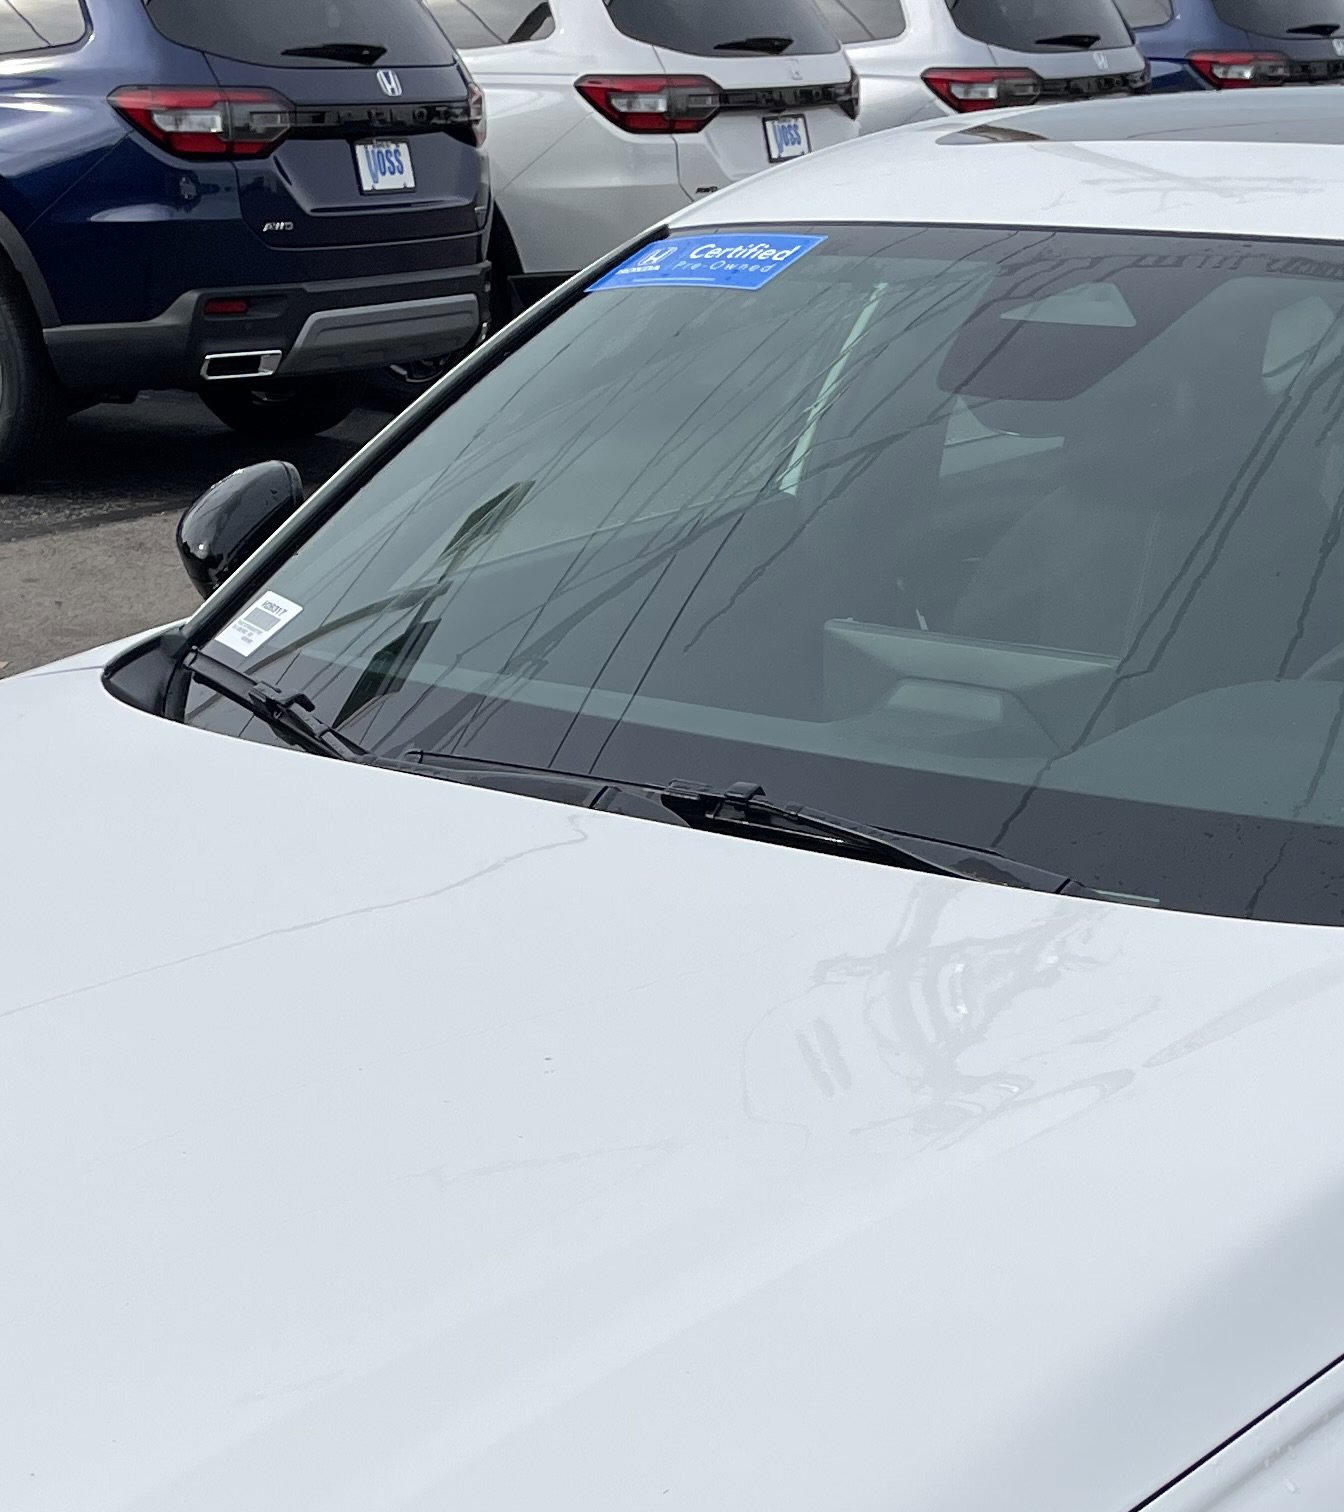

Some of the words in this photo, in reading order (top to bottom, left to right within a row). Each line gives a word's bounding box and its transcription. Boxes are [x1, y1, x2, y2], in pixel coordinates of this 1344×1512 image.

[364, 149, 404, 184] VOSS
[262, 220, 294, 232] AWD
[689, 243, 801, 261] Certified
[672, 260, 777, 274] Pre-Owned
